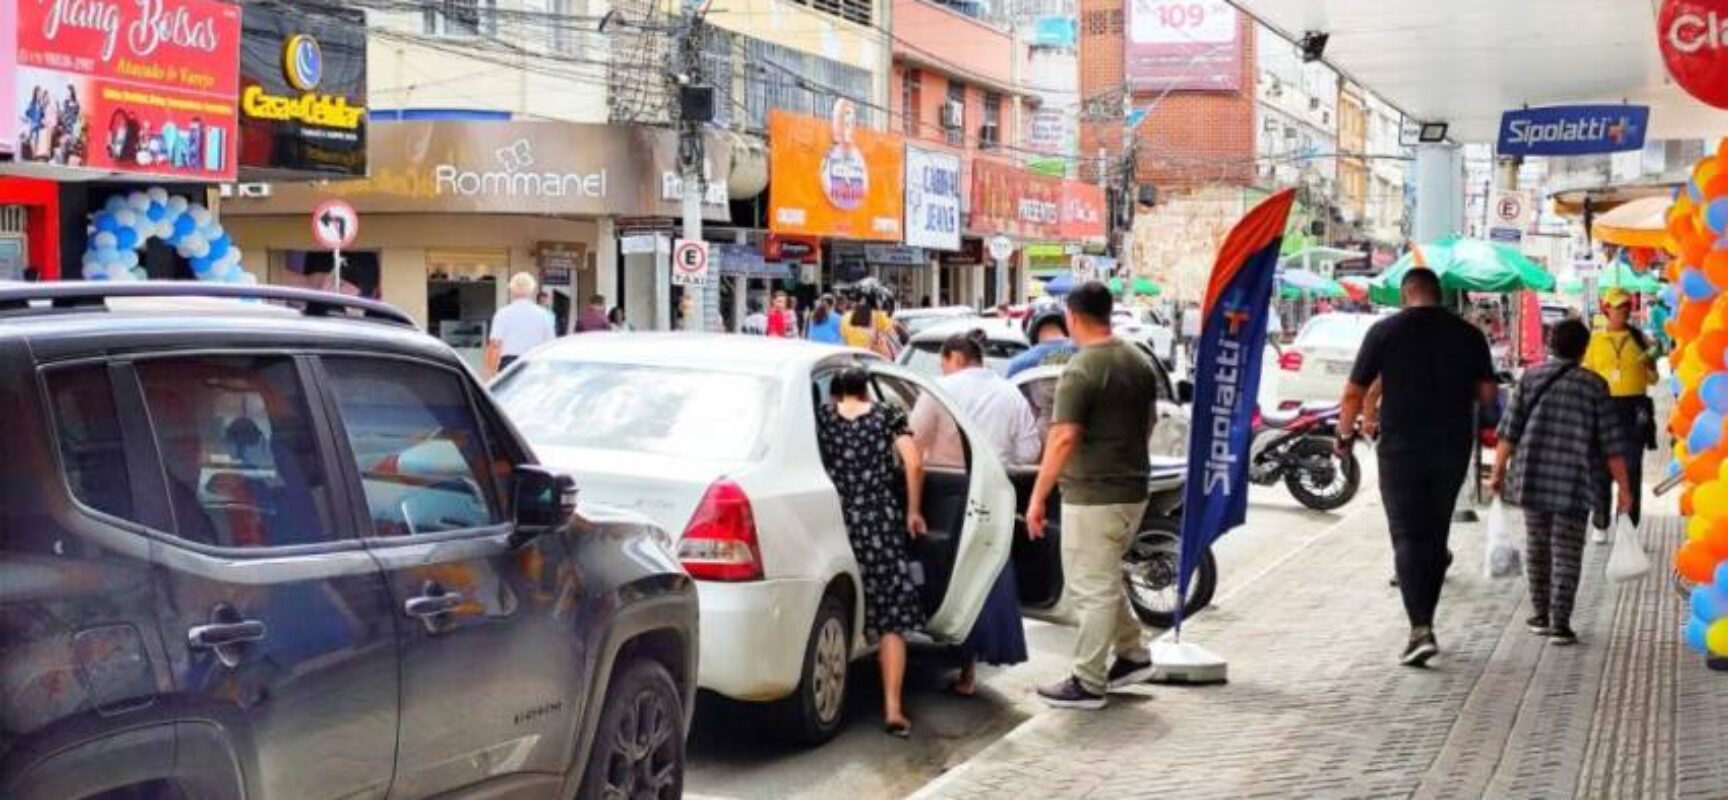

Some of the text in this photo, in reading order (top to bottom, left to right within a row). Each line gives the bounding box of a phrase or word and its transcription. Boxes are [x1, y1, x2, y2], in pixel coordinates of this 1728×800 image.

[1508, 115, 1604, 147] Sipolatti
[434, 163, 607, 199] Rommanel
[1502, 202, 1514, 216] E
[684, 248, 697, 266] E
[1203, 334, 1240, 498] Sipolatti
